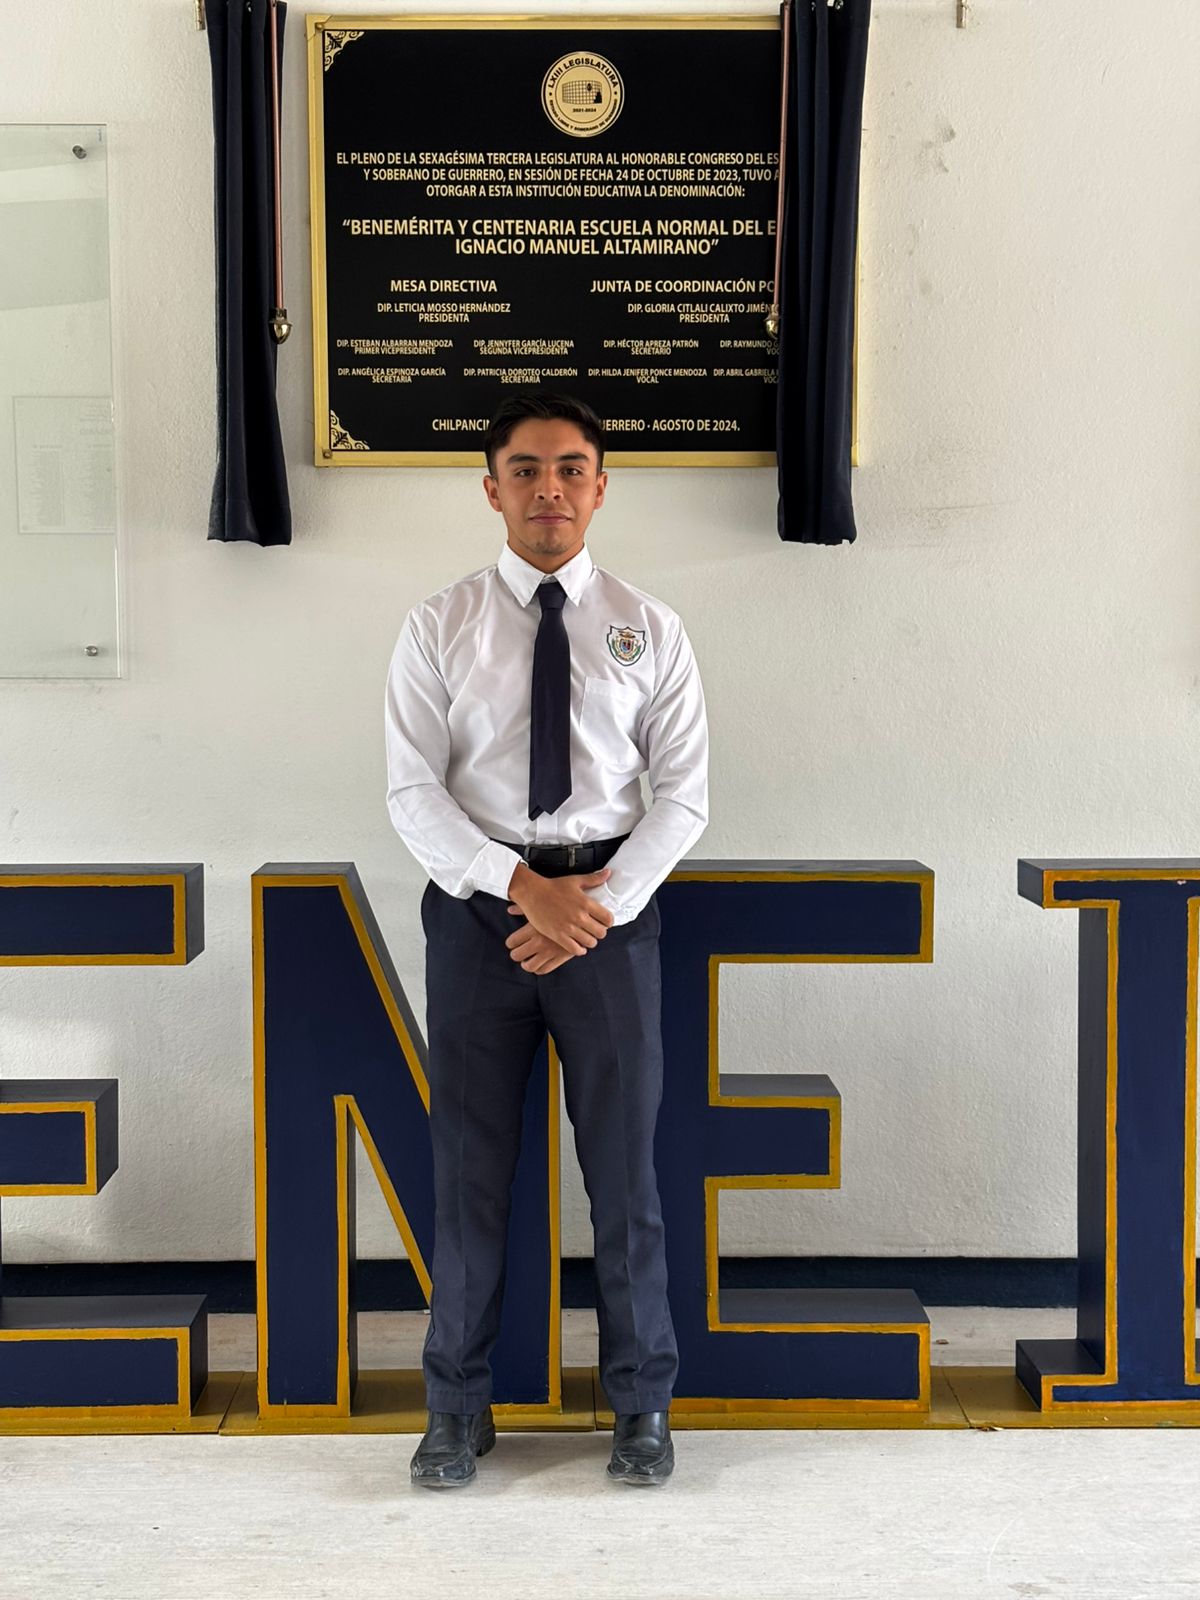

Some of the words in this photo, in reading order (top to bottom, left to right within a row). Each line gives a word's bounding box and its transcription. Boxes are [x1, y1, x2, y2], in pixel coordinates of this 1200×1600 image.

[548, 67, 563, 88] LXIII
[563, 57, 618, 88] LEGISLATURA
[337, 153, 348, 164] EL
[351, 153, 385, 164] PLENO
[388, 153, 401, 164] DE
[404, 153, 416, 164] LA
[419, 150, 485, 164] SEXAGÉSIMA
[487, 153, 532, 164] TERCERA
[535, 153, 603, 164] LEGISLATURA
[606, 153, 619, 164] AL
[622, 153, 685, 164] HONORABLE
[688, 153, 743, 164] CONGRESO
[746, 153, 765, 164] DEL
[364, 169, 370, 180] Y
[373, 169, 429, 180] SOBERANO
[432, 169, 446, 180] DE
[448, 169, 506, 182] GUERRERO,
[509, 169, 522, 180] EN
[525, 167, 561, 180] SESIÓN
[564, 169, 577, 180] DE
[580, 169, 613, 181] FECHA
[616, 169, 628, 180] 24
[631, 169, 644, 180] DE
[647, 169, 694, 181] OCTUBRE
[698, 169, 711, 180] DE
[714, 169, 741, 182] 2023,
[743, 169, 771, 180] TUVO
[427, 185, 476, 196] OTORGAR
[479, 185, 486, 196] A
[489, 185, 513, 196] ESTA
[516, 183, 581, 197] INSTITUCIÓN
[584, 185, 641, 197] EDUCATIVA
[644, 185, 657, 197] LA
[660, 183, 745, 197] DENOMINACIÓN:
[342, 216, 454, 235] “BENEMÉRITA
[458, 220, 468, 235] Y
[472, 220, 576, 235] CENTENARIA
[581, 220, 652, 235] ESCUELA
[658, 220, 728, 235] NORMAL
[733, 220, 763, 235] DEL
[456, 239, 525, 254] IGNACIO
[530, 239, 599, 254] MANUEL
[604, 239, 719, 254] ALTAMIRANO”
[391, 280, 426, 292] MESA
[430, 280, 497, 292] DIRECTIVA
[591, 280, 631, 292] JUNTA
[635, 280, 652, 292] DE
[655, 278, 755, 292] COORDINACIÓN
[378, 303, 393, 312] DIP.
[395, 303, 425, 312] LETICIA
[427, 303, 457, 312] MOSSO
[460, 302, 510, 312] HERNÁNDEZ
[628, 304, 643, 312] DIP.
[645, 304, 675, 312] GLORIA
[677, 304, 708, 312] CITLALI
[710, 304, 745, 312] CALIXTO
[746, 301, 769, 313] JIMÉN
[419, 313, 469, 323] PRESIDENTA
[680, 314, 729, 324] PRESIDENTA
[337, 339, 350, 348] DIP.
[351, 339, 380, 348] ESTEBAN
[381, 339, 417, 348] ALBARRAN
[419, 339, 453, 348] MENDOZA
[474, 339, 487, 348] DIP.
[487, 339, 520, 348] JENNYFER
[521, 339, 546, 348] GARCÍA
[547, 339, 575, 348] LUCENA
[604, 340, 617, 349] DIP.
[618, 340, 643, 349] HÉCTOR
[644, 340, 671, 349] APREZA
[672, 340, 699, 349] PATRÓN
[720, 340, 733, 349] DIP.
[734, 340, 773, 349] RAYMUNDO
[355, 347, 379, 355] PRIMER
[381, 347, 436, 355] VICEPRESIDENTE
[480, 347, 512, 355] SEGUNDA
[513, 347, 568, 355] VICEPRESIDENTA
[631, 348, 672, 356] SECRETARIO
[767, 348, 780, 356] VOC
[338, 367, 351, 376] DIP.
[352, 367, 385, 376] ANGÉLICA
[386, 367, 420, 376] ESPINOZA
[421, 367, 446, 376] GARCÍA
[464, 367, 477, 376] DIP.
[477, 367, 506, 376] PATRICIA
[507, 367, 541, 376] DOROTEO
[542, 367, 578, 376] CALDERÓN
[588, 368, 601, 377] DIP.
[602, 368, 621, 377] HILDA
[622, 368, 649, 377] JENIFER
[650, 368, 672, 377] PONCE
[674, 368, 707, 377] MENDOZA
[714, 368, 726, 377] DIP.
[726, 368, 744, 377] ABRIL
[745, 368, 775, 377] GABRIELA
[372, 375, 412, 384] SECRETARIA
[501, 375, 541, 384] SECRETARIA
[636, 376, 659, 384] VOCAL
[432, 419, 490, 431] CHILPANCI
[598, 419, 645, 431] UERRERO
[652, 419, 694, 431] AGOSTO
[697, 420, 710, 431] DE
[713, 420, 740, 431] 2024.
